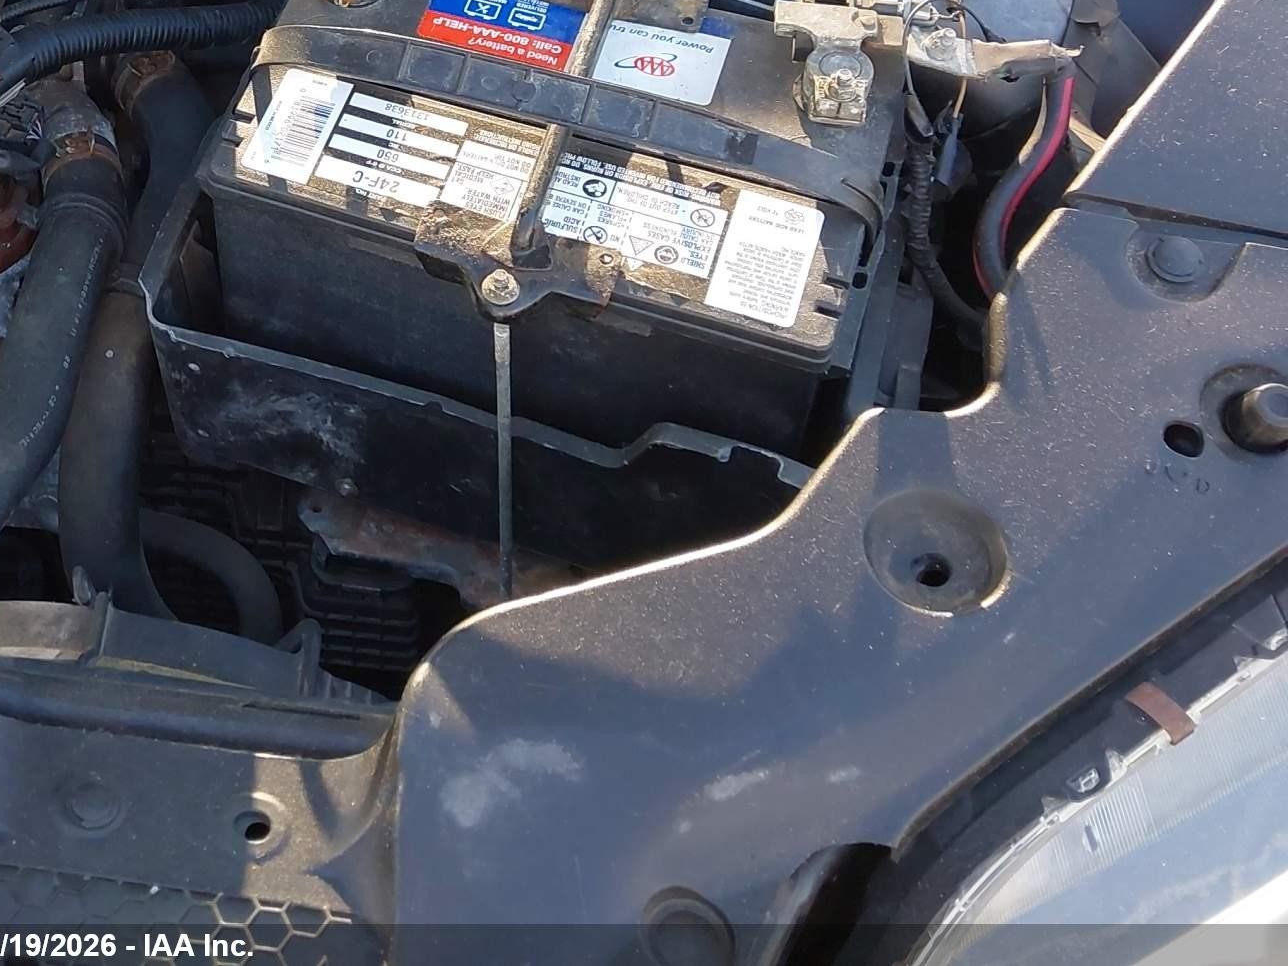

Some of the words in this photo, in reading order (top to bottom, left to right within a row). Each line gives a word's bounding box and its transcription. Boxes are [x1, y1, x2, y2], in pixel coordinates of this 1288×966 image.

[431, 14, 530, 46] 800-AAA-HELP
[608, 23, 626, 33] tru
[628, 27, 649, 38] can
[466, 34, 516, 54] battery?
[650, 31, 674, 44] you
[515, 47, 526, 55] a
[530, 39, 563, 54] Call:
[674, 38, 714, 54] Power
[525, 49, 559, 65] Need
[634, 53, 673, 78] AAA
[385, 127, 408, 142] 110
[374, 148, 400, 163] 650
[575, 154, 602, 167] FOLLOW
[453, 169, 484, 183] MEDICAL
[475, 169, 494, 179] HELP
[350, 168, 401, 194] 24F-C
[561, 178, 579, 188] READ
[461, 193, 508, 212] IMMEDIATELY
[463, 200, 483, 211] EYES
[491, 194, 511, 205] WITH
[551, 201, 572, 211] CAUSE
[554, 194, 577, 206] SEVERE
[576, 201, 587, 209] OR
[571, 206, 585, 215] CAN
[542, 217, 578, 234] SULFURIC
[562, 215, 581, 226] ACID
[645, 229, 671, 242] GASES
[670, 236, 712, 254] EXPLOSIVE
[678, 255, 706, 270] SHIELD
